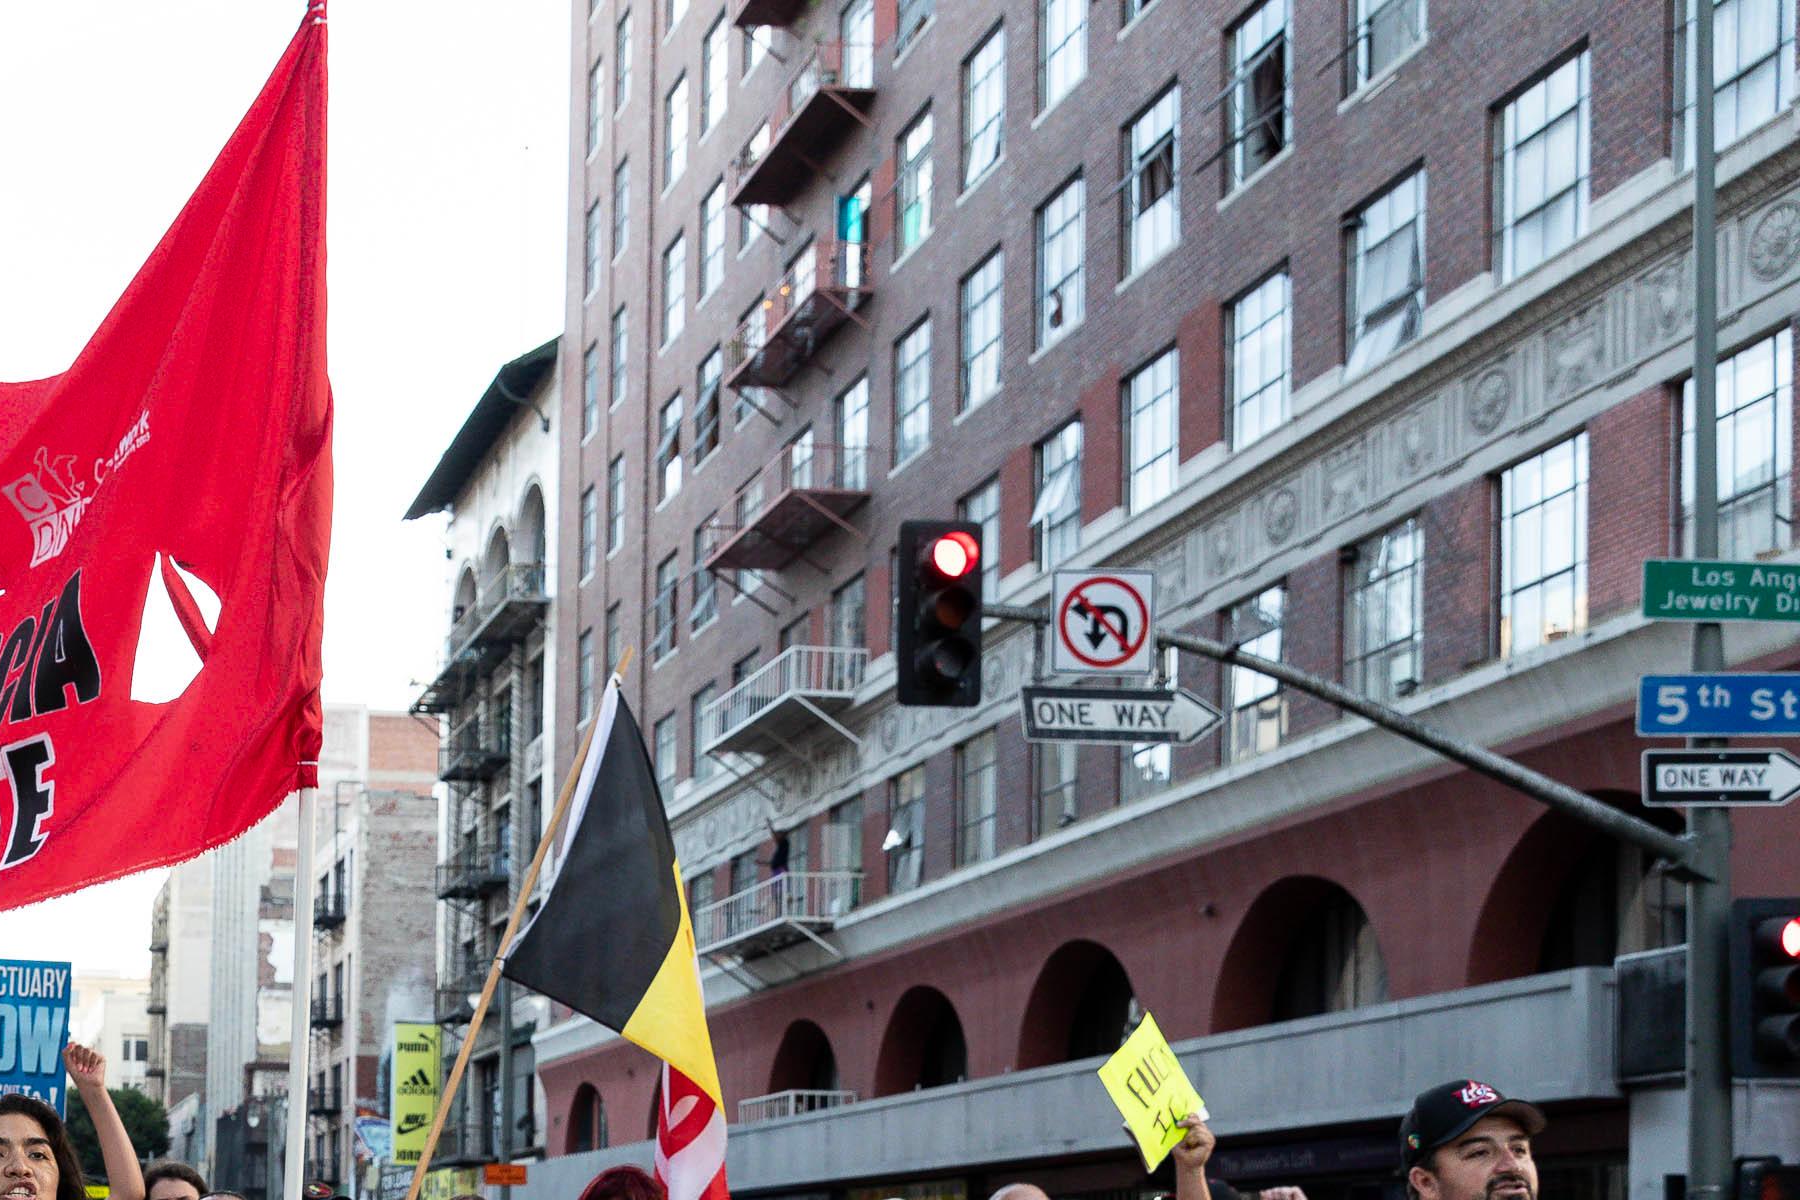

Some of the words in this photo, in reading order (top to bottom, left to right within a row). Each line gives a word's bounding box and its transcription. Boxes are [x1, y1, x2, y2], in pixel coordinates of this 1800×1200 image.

[1691, 566, 1736, 588] Los
[1749, 567, 1800, 594] Ang
[1659, 591, 1760, 616] Jewelry
[1037, 702, 1095, 727] ONE
[1113, 705, 1171, 728] WAY
[1655, 683, 1732, 726] 5th
[1749, 688, 1798, 721] St
[1663, 768, 1711, 787] ONE
[1719, 767, 1767, 787] WAY
